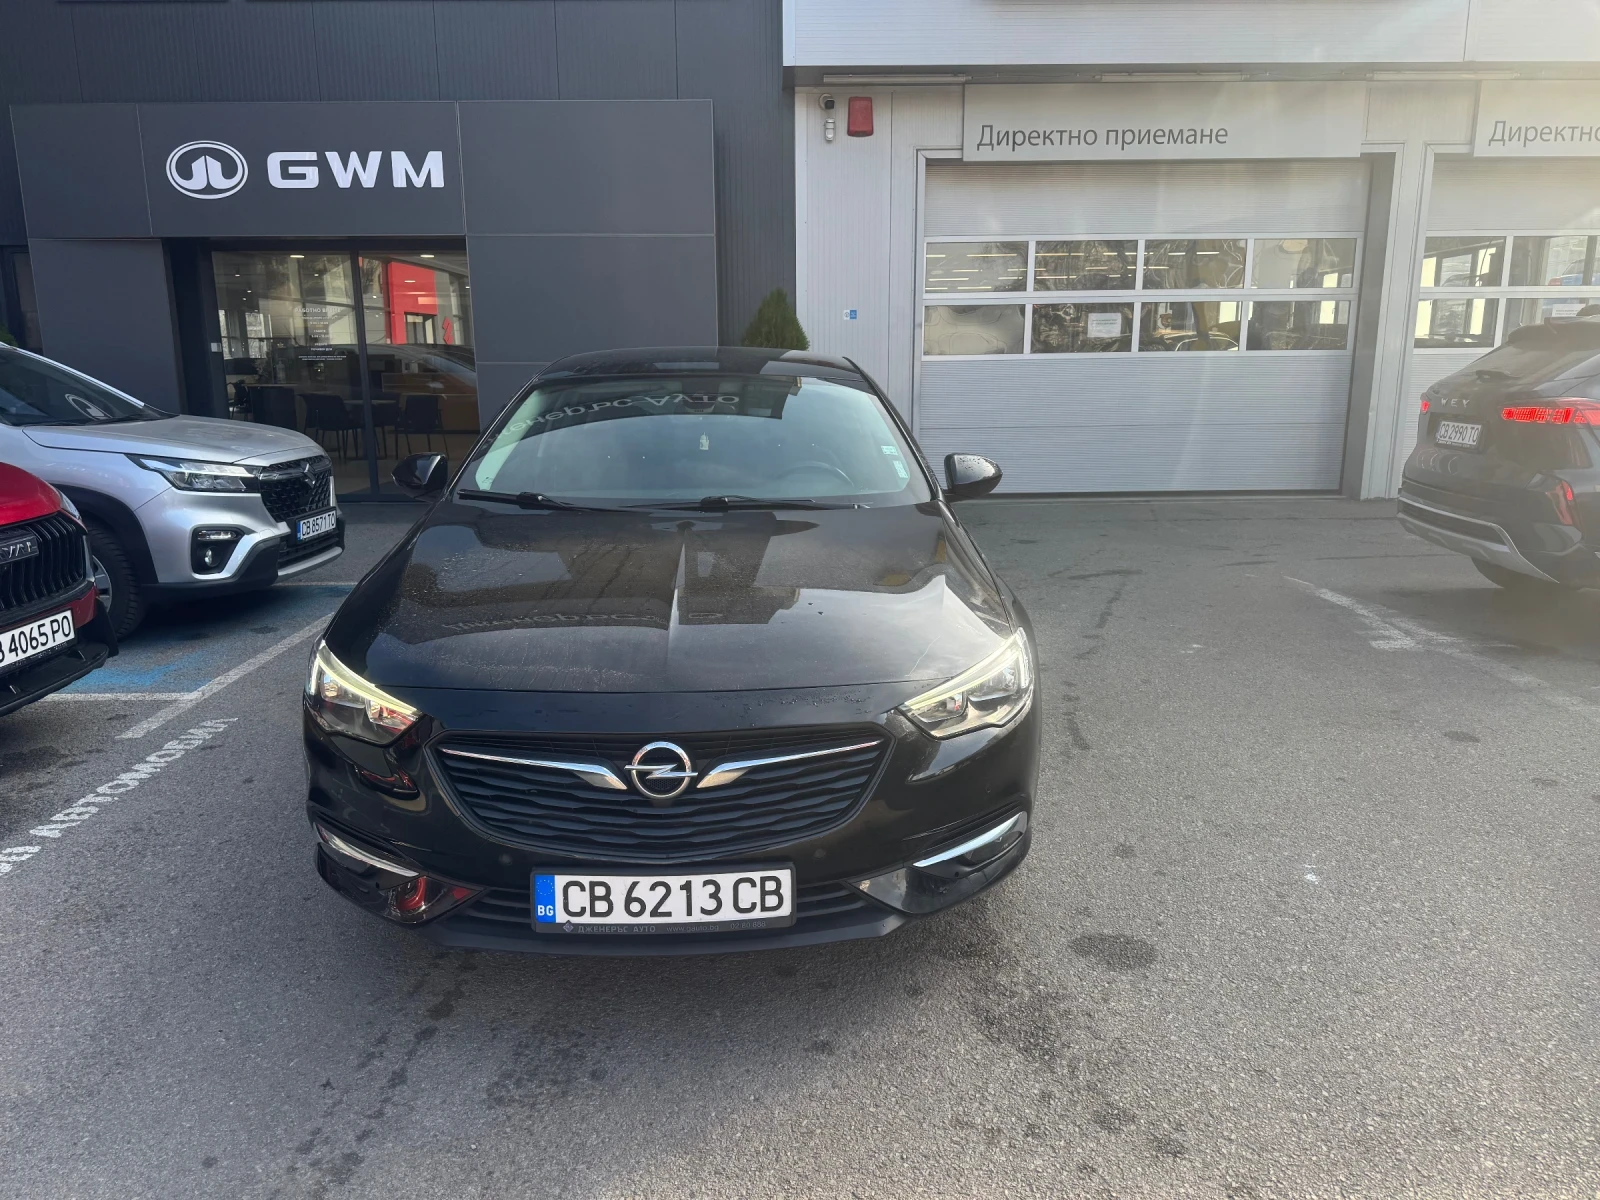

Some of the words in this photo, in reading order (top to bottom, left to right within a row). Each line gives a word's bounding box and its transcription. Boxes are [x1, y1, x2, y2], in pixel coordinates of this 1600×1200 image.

[977, 124, 1099, 152] Директно
[1105, 125, 1229, 151] приемане
[266, 150, 445, 189] GWM
[1441, 397, 1470, 408] WEY
[301, 520, 311, 536] CB
[311, 515, 327, 533] 8571
[327, 512, 336, 527] TO
[9, 623, 48, 657] 4065
[50, 615, 72, 643] PO
[562, 880, 614, 918] CB
[624, 878, 723, 918] 6213
[732, 875, 785, 914] CB
[537, 905, 554, 917] BG
[578, 925, 628, 934] ДЖЕНЕРЪС
[633, 924, 656, 933] АУТО
[666, 923, 720, 933] www.gauto.bg
